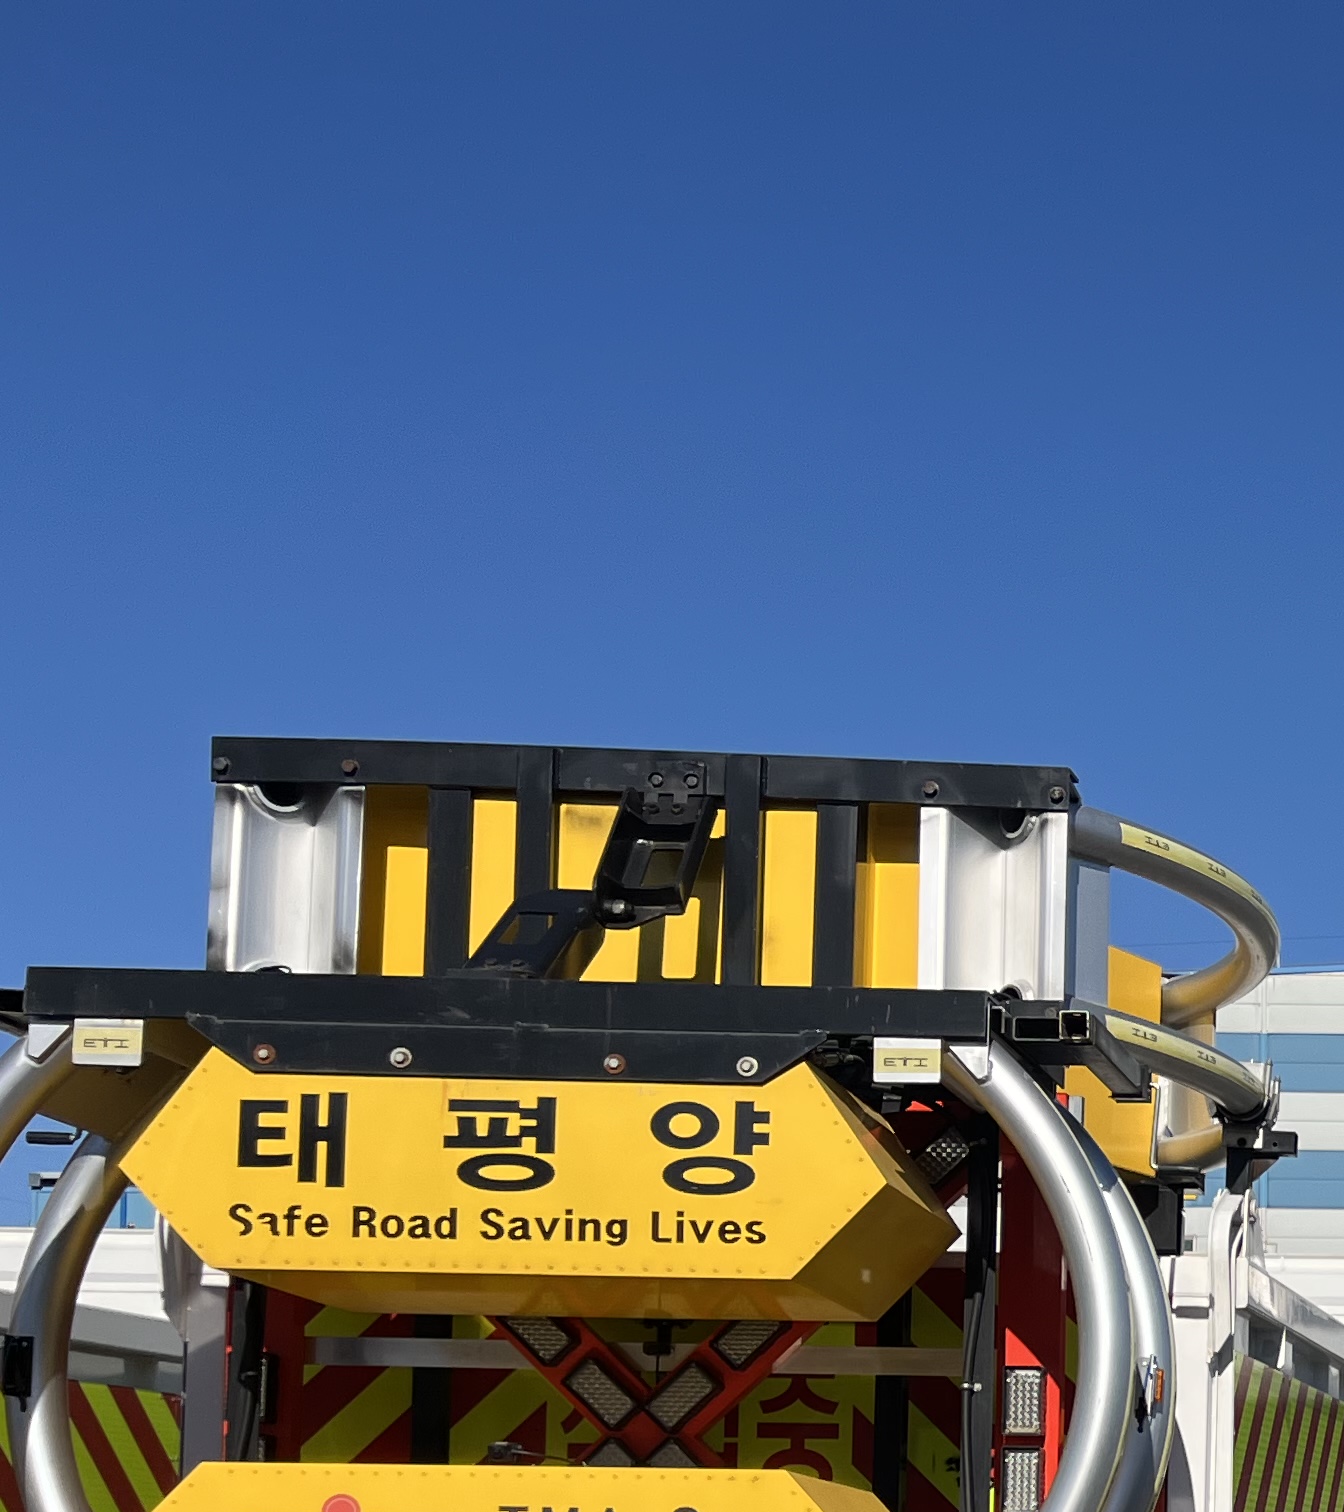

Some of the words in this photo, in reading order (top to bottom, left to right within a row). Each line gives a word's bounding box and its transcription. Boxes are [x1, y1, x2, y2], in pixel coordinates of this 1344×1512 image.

[228, 1204, 330, 1238] Safe
[351, 1205, 458, 1240] Road
[480, 1207, 628, 1247] Saving
[650, 1211, 767, 1244] Lives
